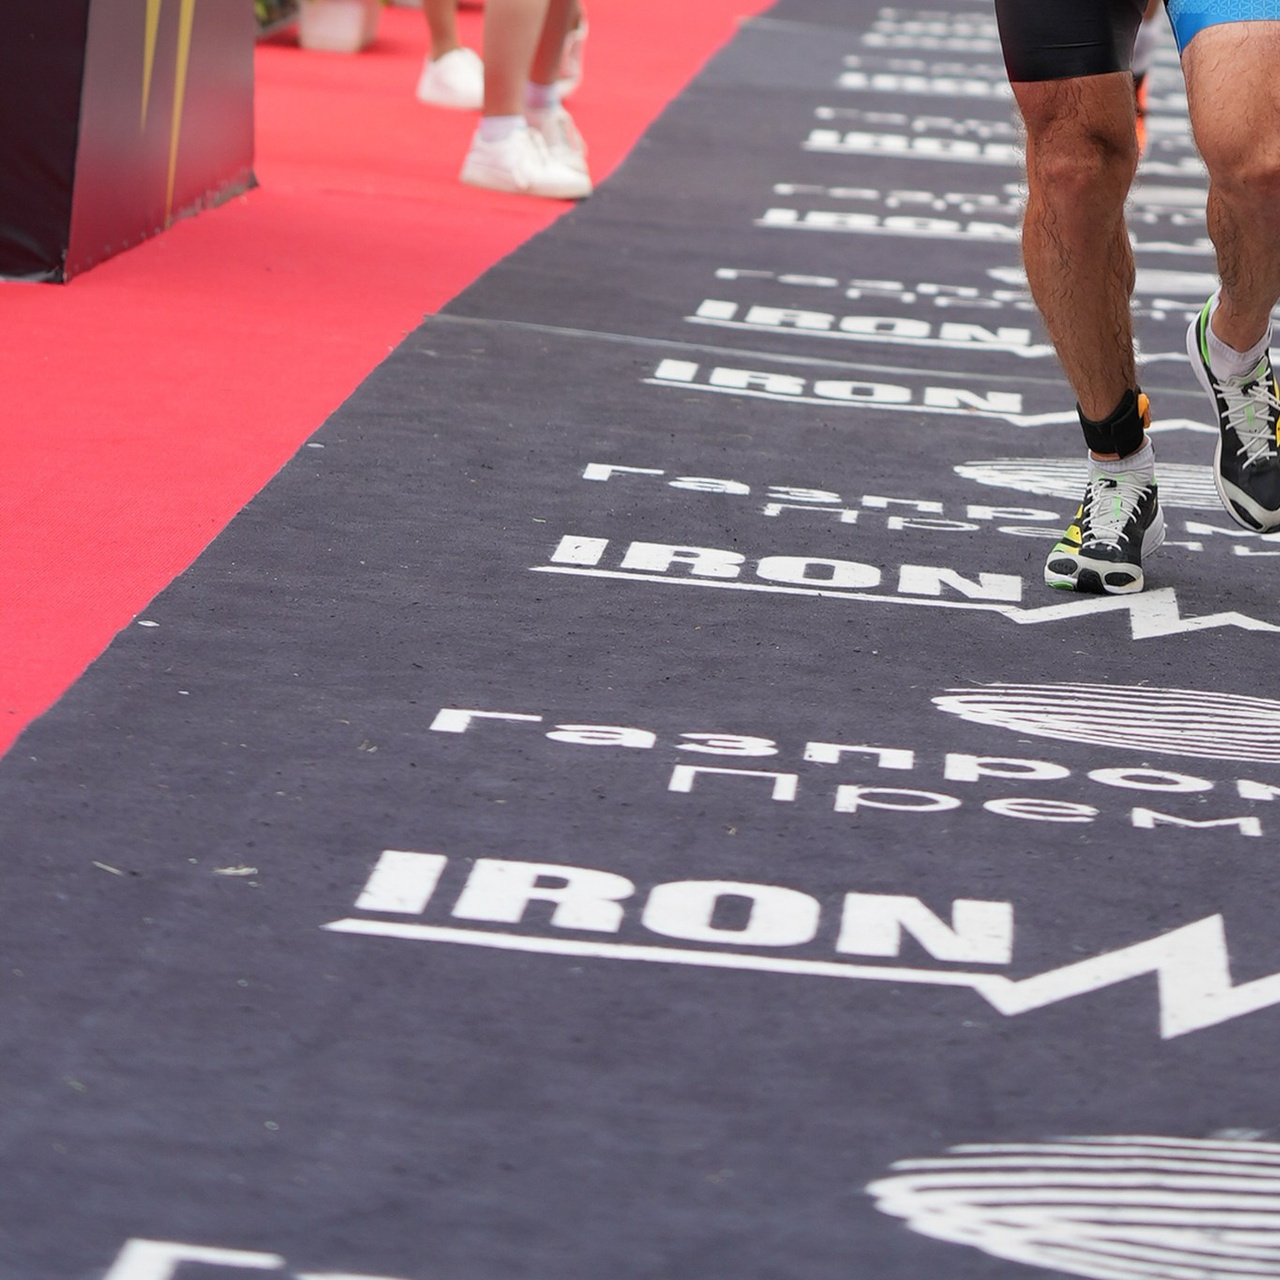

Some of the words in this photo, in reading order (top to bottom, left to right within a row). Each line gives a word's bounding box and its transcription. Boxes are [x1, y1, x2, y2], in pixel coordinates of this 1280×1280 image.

[696, 299, 1031, 346] IRON
[653, 358, 1023, 414] IRON
[550, 534, 1022, 602] IRON
[355, 850, 1014, 964] IRON
